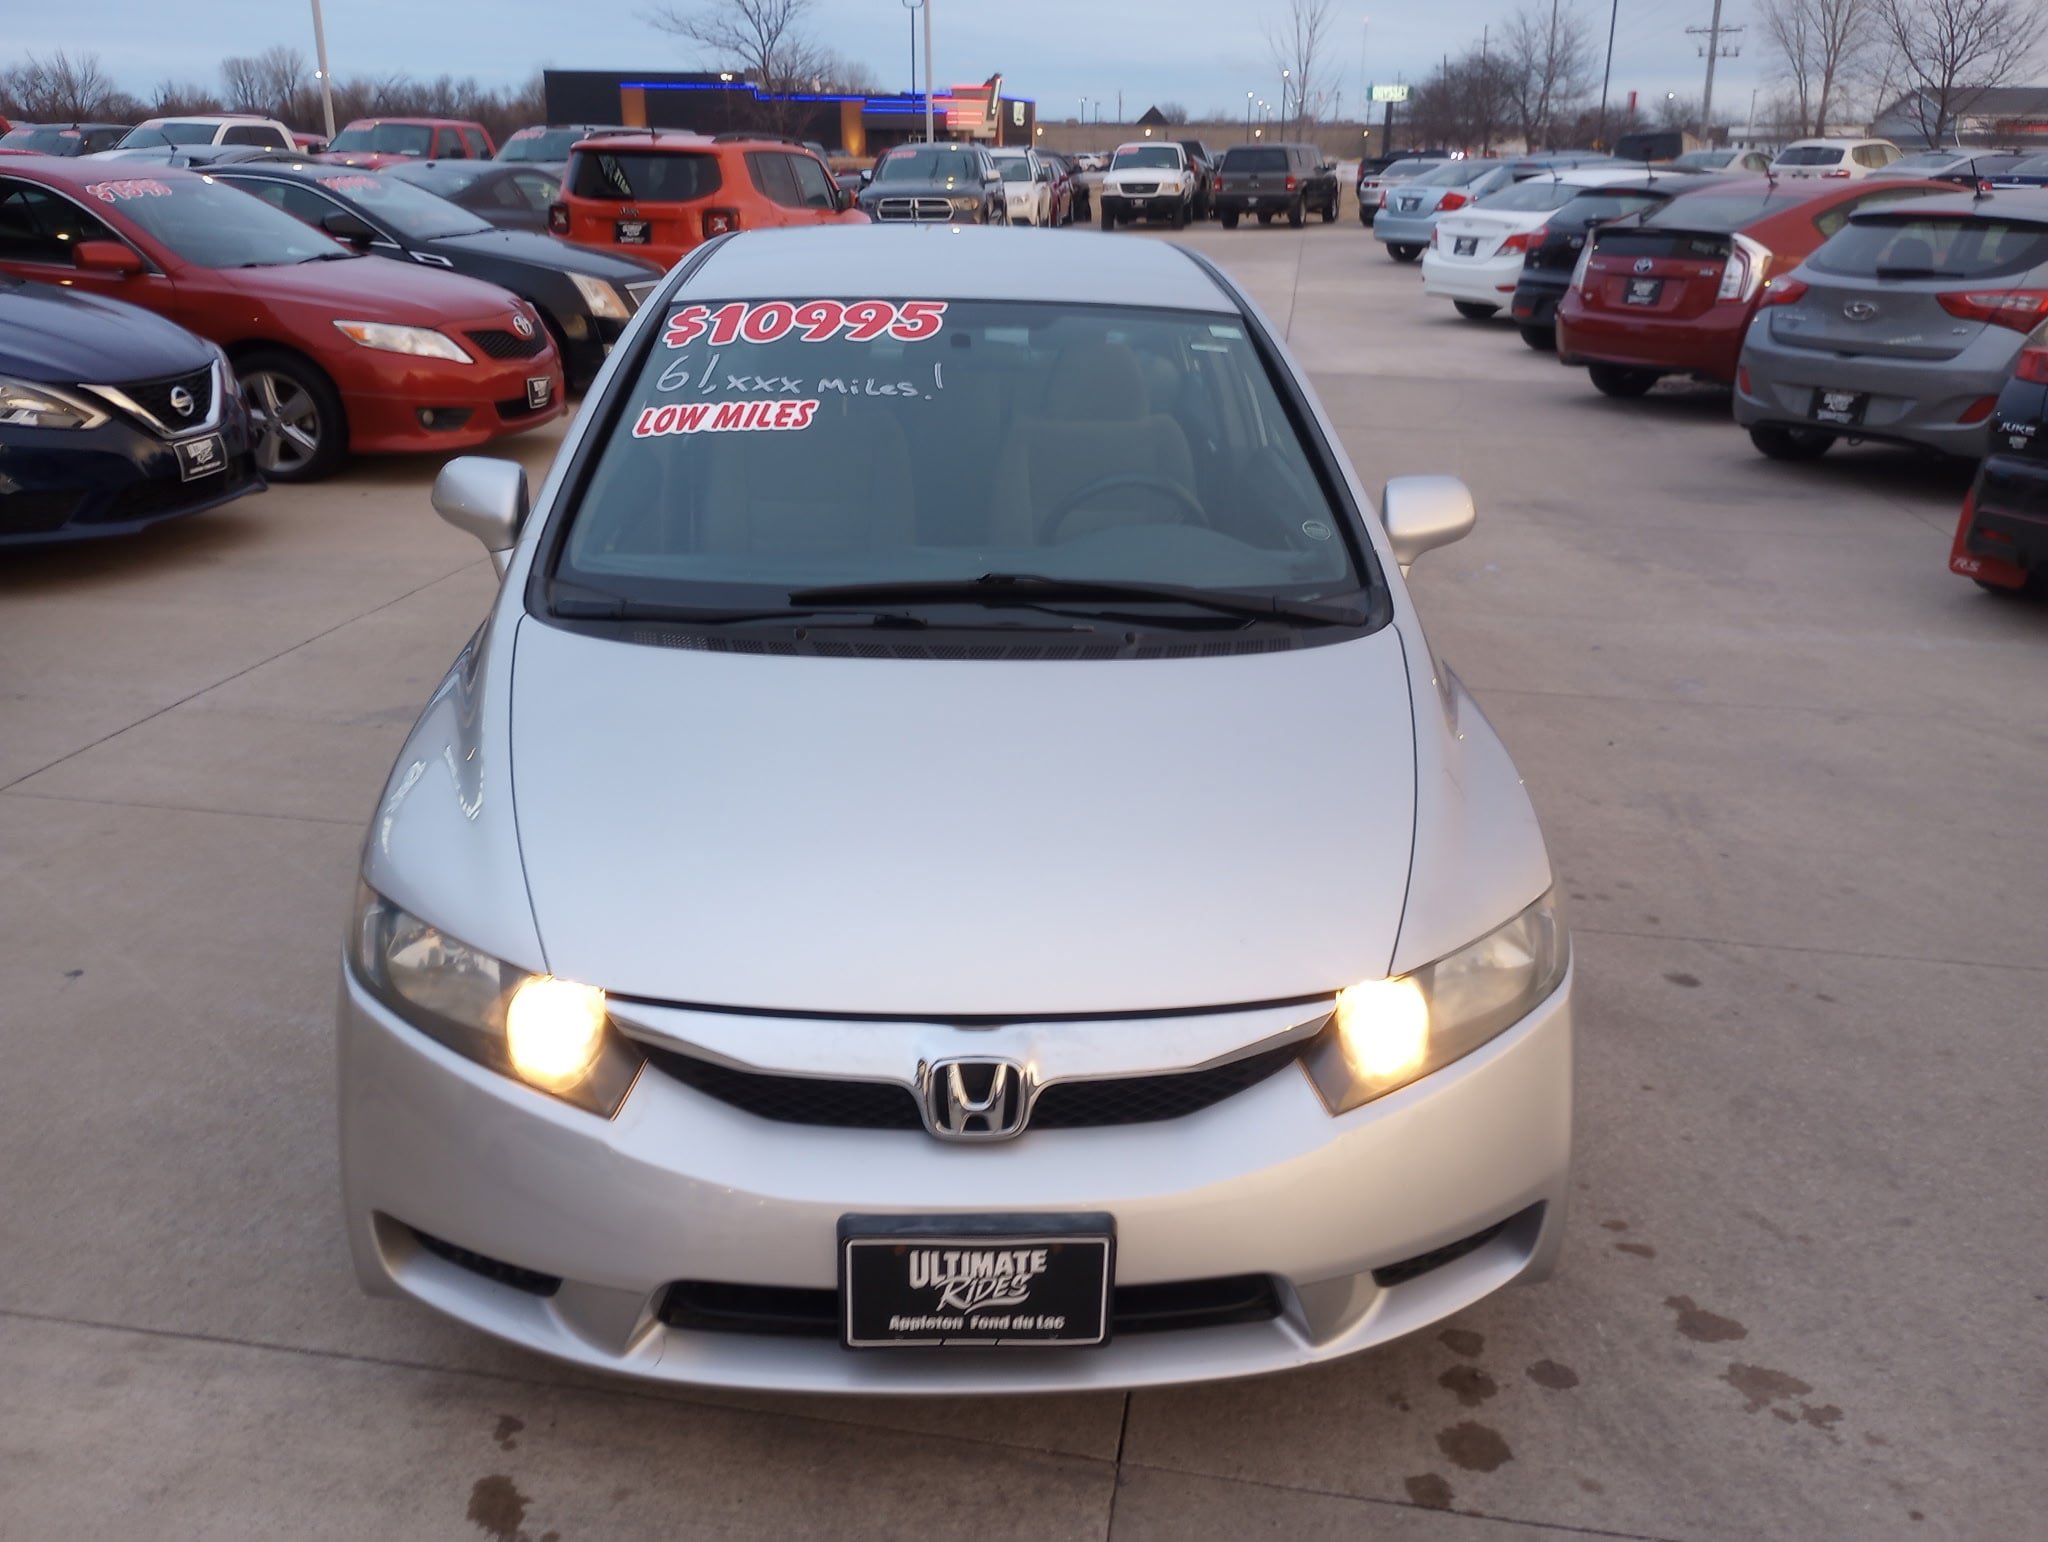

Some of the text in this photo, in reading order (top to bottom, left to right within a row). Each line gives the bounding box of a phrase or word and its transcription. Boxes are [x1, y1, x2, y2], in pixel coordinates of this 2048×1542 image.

[663, 301, 948, 348] $10995
[632, 399, 820, 438] LOW MILES
[908, 1249, 1049, 1290] ULTIMATE
[970, 1314, 1011, 1330] Fond
[1012, 1314, 1035, 1330] du
[1036, 1314, 1066, 1330] Lac
